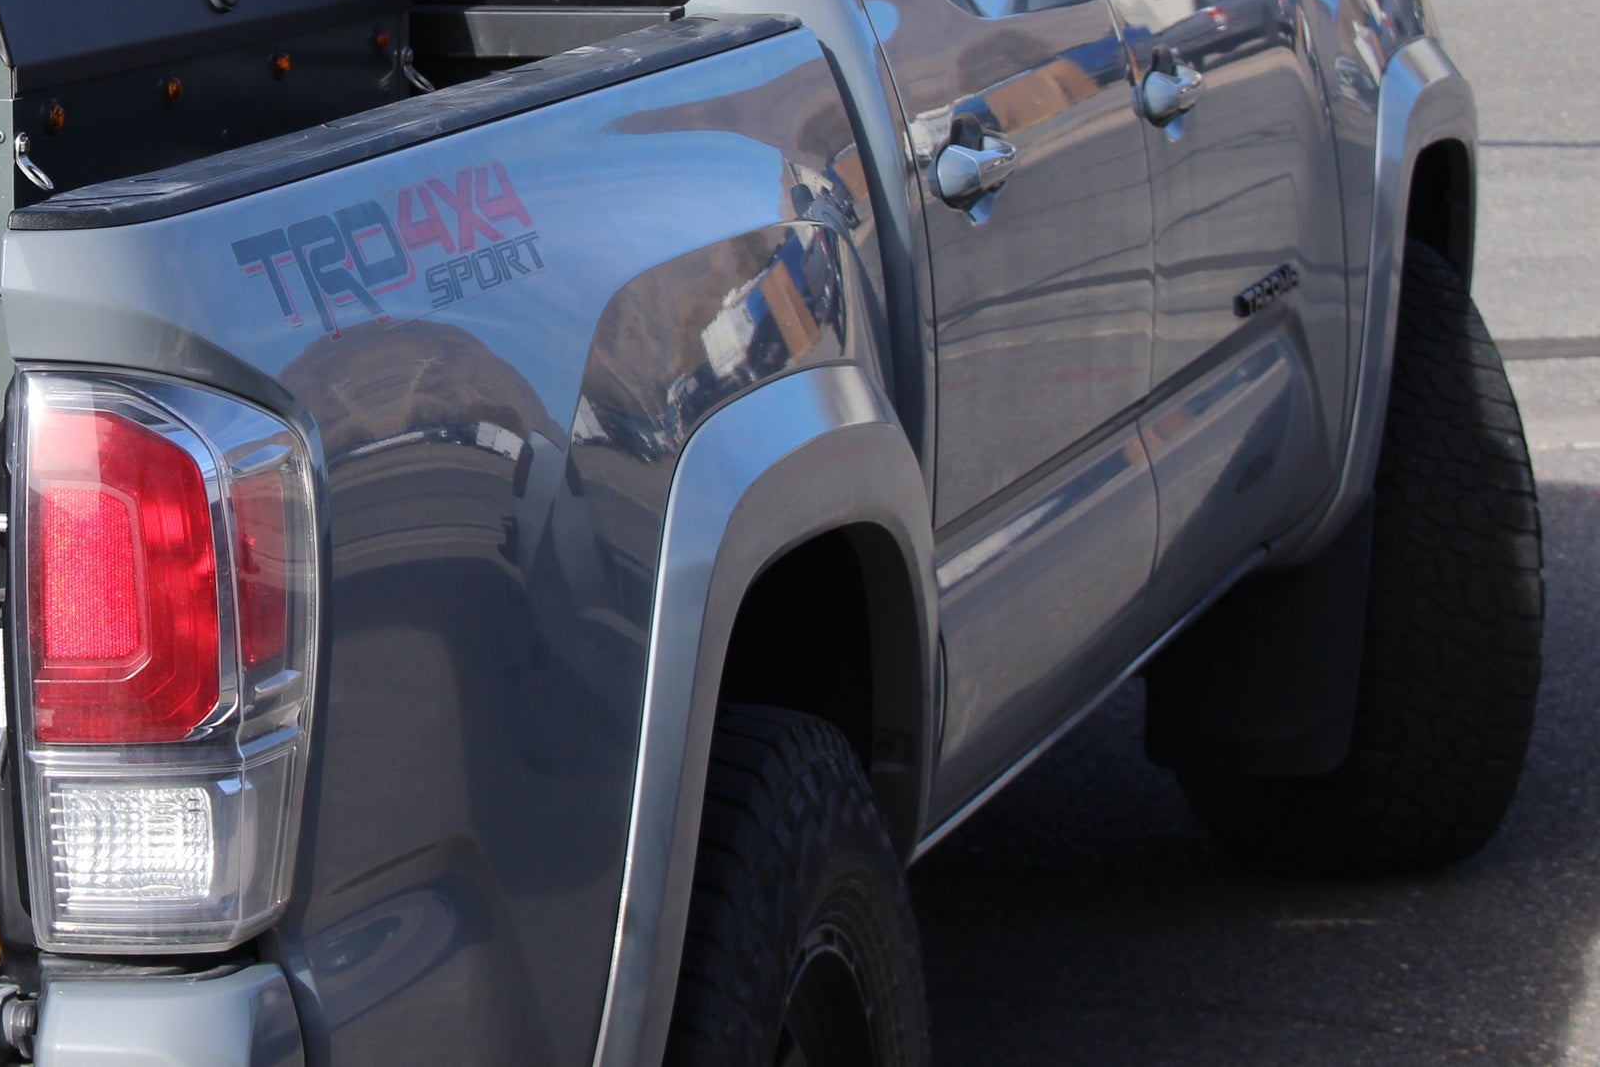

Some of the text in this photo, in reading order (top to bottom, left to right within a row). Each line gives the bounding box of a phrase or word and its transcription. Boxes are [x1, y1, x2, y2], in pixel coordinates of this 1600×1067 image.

[230, 159, 534, 341] TRD 4X4
[424, 230, 545, 310] SPORT
